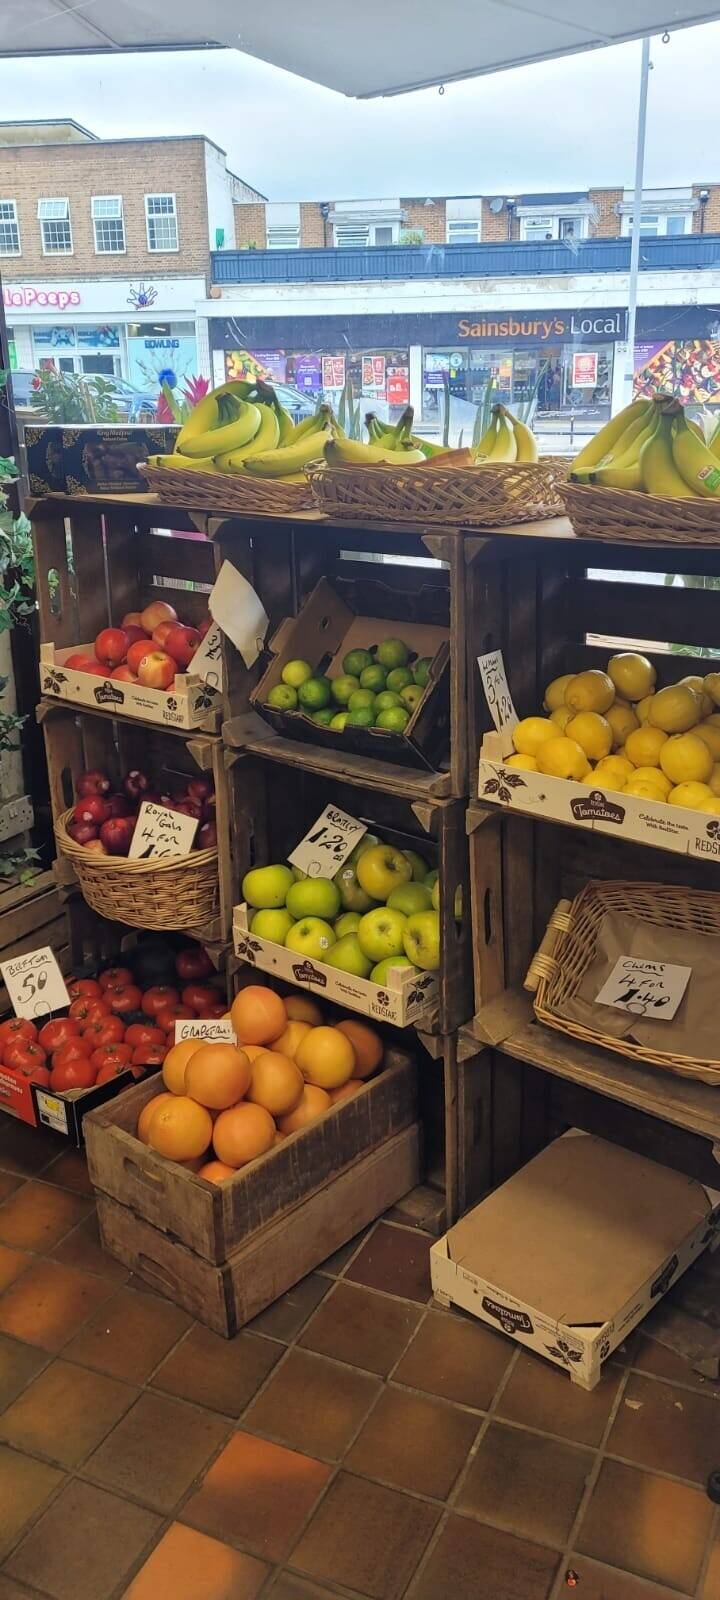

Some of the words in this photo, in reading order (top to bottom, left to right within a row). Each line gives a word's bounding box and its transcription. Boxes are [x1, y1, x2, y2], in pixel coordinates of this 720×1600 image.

[457, 313, 565, 340] Sainsbury's
[570, 312, 621, 335] Local
[145, 339, 179, 349] BOWLING
[573, 803, 622, 821] Tomatoes
[141, 827, 155, 842] 4
[618, 973, 637, 987] 4
[613, 988, 671, 1007] 1.40
[485, 1300, 531, 1328] Tomatoes
